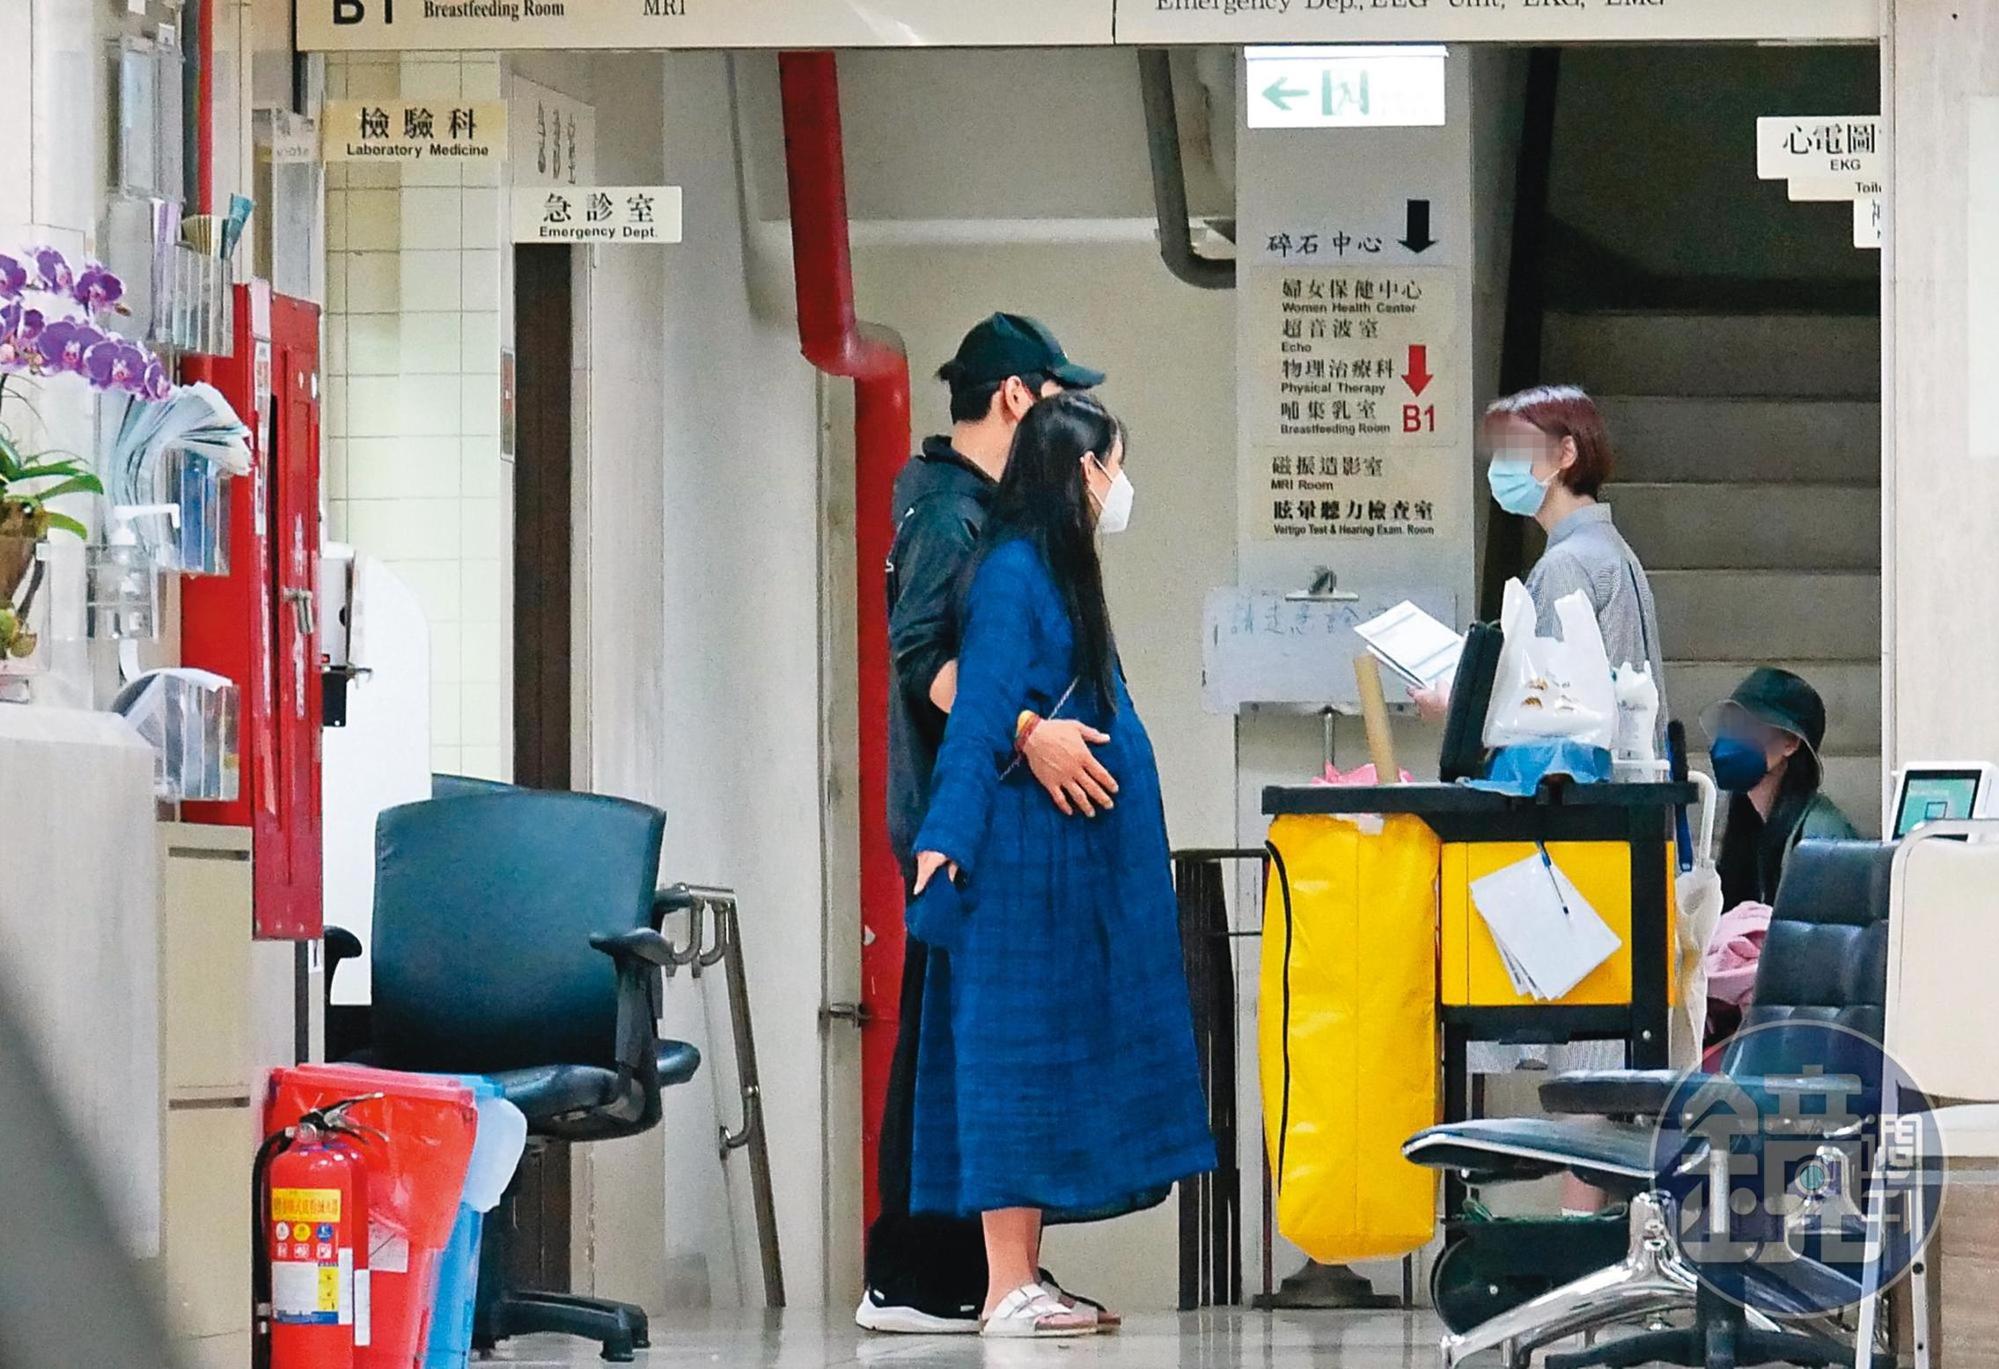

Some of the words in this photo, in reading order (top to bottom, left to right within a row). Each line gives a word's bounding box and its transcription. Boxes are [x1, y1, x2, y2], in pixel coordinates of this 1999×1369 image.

[423, 0, 520, 22] Breastfeeding
[523, 0, 565, 17] Room
[643, 0, 686, 16] MRI
[360, 106, 477, 140] 檢驗科
[346, 143, 423, 159] Laboratory
[429, 143, 489, 156] Medicine
[1830, 159, 1861, 171] EKG
[1855, 181, 1881, 194] Toil
[543, 192, 655, 223] 急診室
[539, 225, 616, 240] Emergency
[622, 226, 659, 239] Dept.
[1266, 230, 1383, 258] 碎石中心
[1282, 278, 1422, 300] 婦女保健中心
[1281, 302, 1328, 314] Women
[1331, 302, 1371, 313] Health
[1375, 301, 1416, 314] Center
[1282, 318, 1378, 339] 超音波室
[1281, 341, 1312, 353] Echo
[1282, 358, 1393, 379] 物理治療科
[1280, 381, 1332, 396] Physical
[1337, 381, 1386, 396] Therapy
[1402, 404, 1435, 433] B1
[1280, 423, 1356, 436] Breastfeeding
[1358, 422, 1391, 434] Room
[1272, 455, 1383, 477] 磁振造影室
[1270, 479, 1294, 490] MRI
[1297, 479, 1334, 491] Room
[1273, 499, 1433, 521] 眩暈聽力檢查室
[1273, 524, 1307, 537] Vertigo
[1308, 523, 1328, 535] Test
[1329, 524, 1337, 535] &
[1338, 524, 1375, 537] Hearing
[1406, 523, 1435, 535] Room
